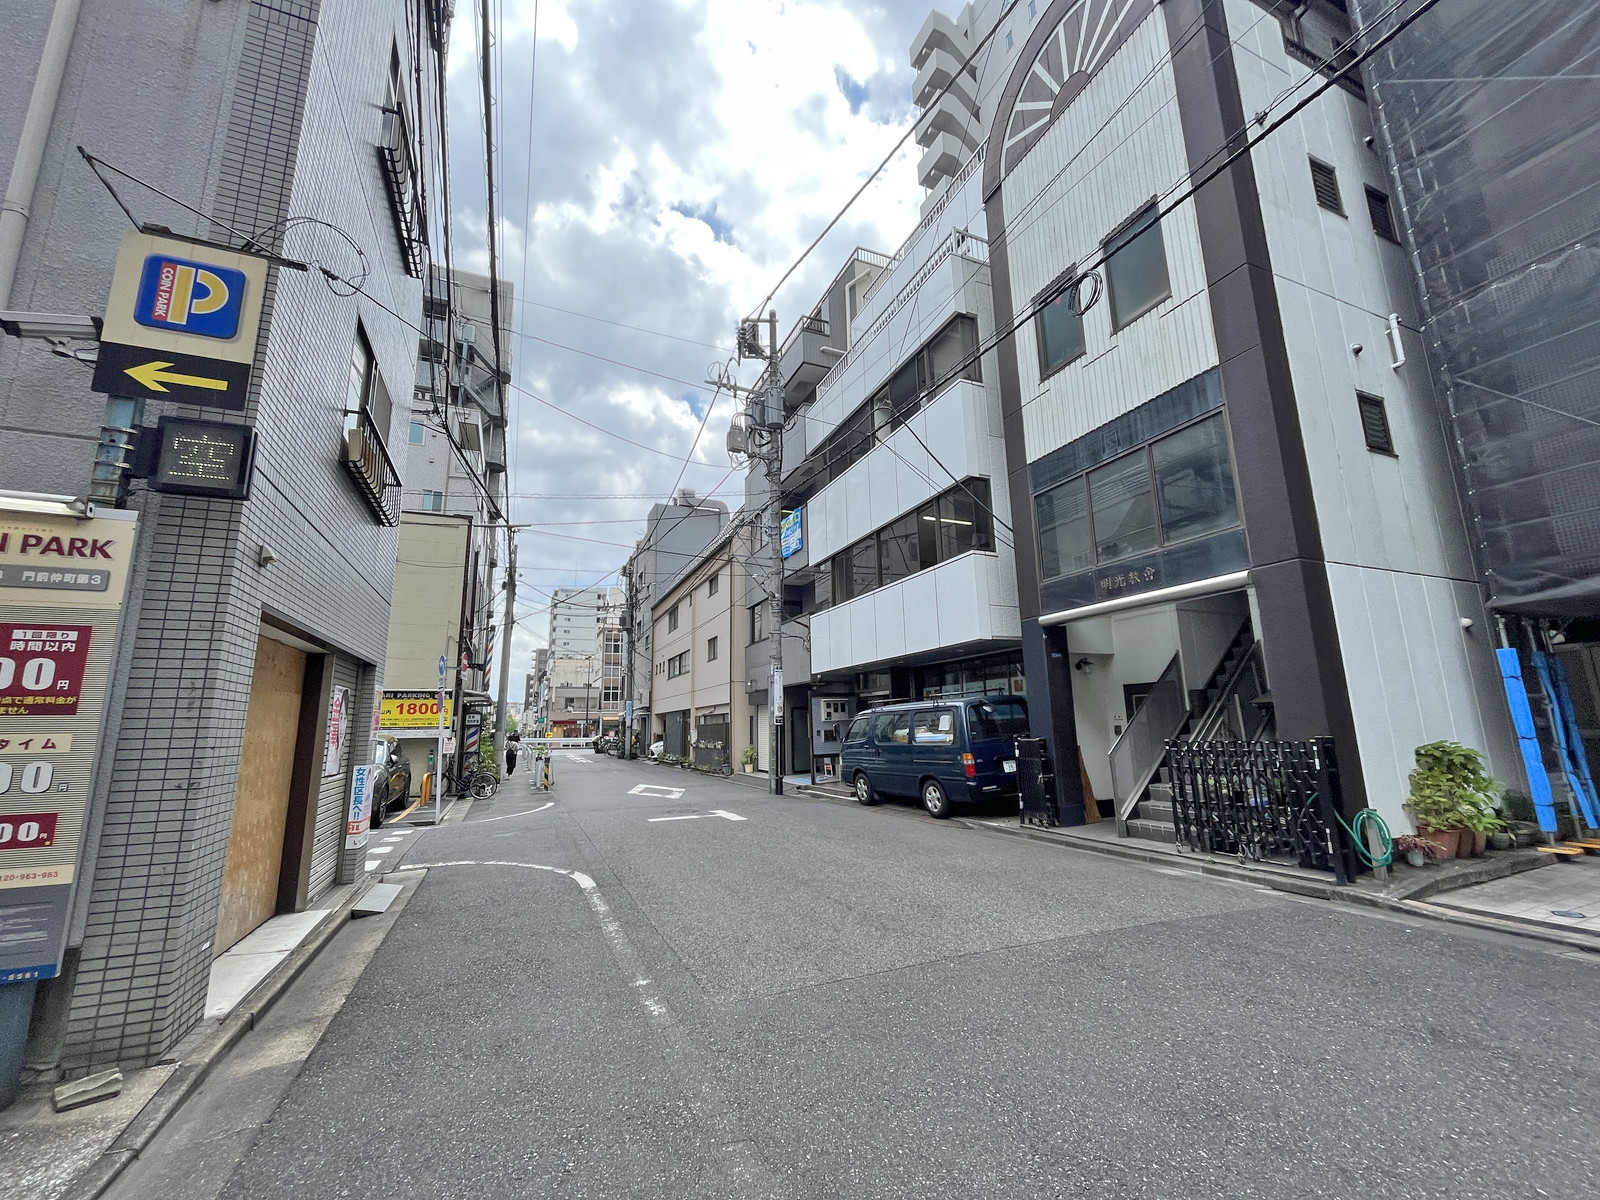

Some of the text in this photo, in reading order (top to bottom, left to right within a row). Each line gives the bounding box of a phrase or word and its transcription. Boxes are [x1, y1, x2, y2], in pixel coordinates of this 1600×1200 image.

[154, 267, 175, 318] COIN PARK
[19, 534, 114, 559] PARK
[9, 640, 76, 652] 時間以内
[0, 695, 77, 705] 点で通常料金が
